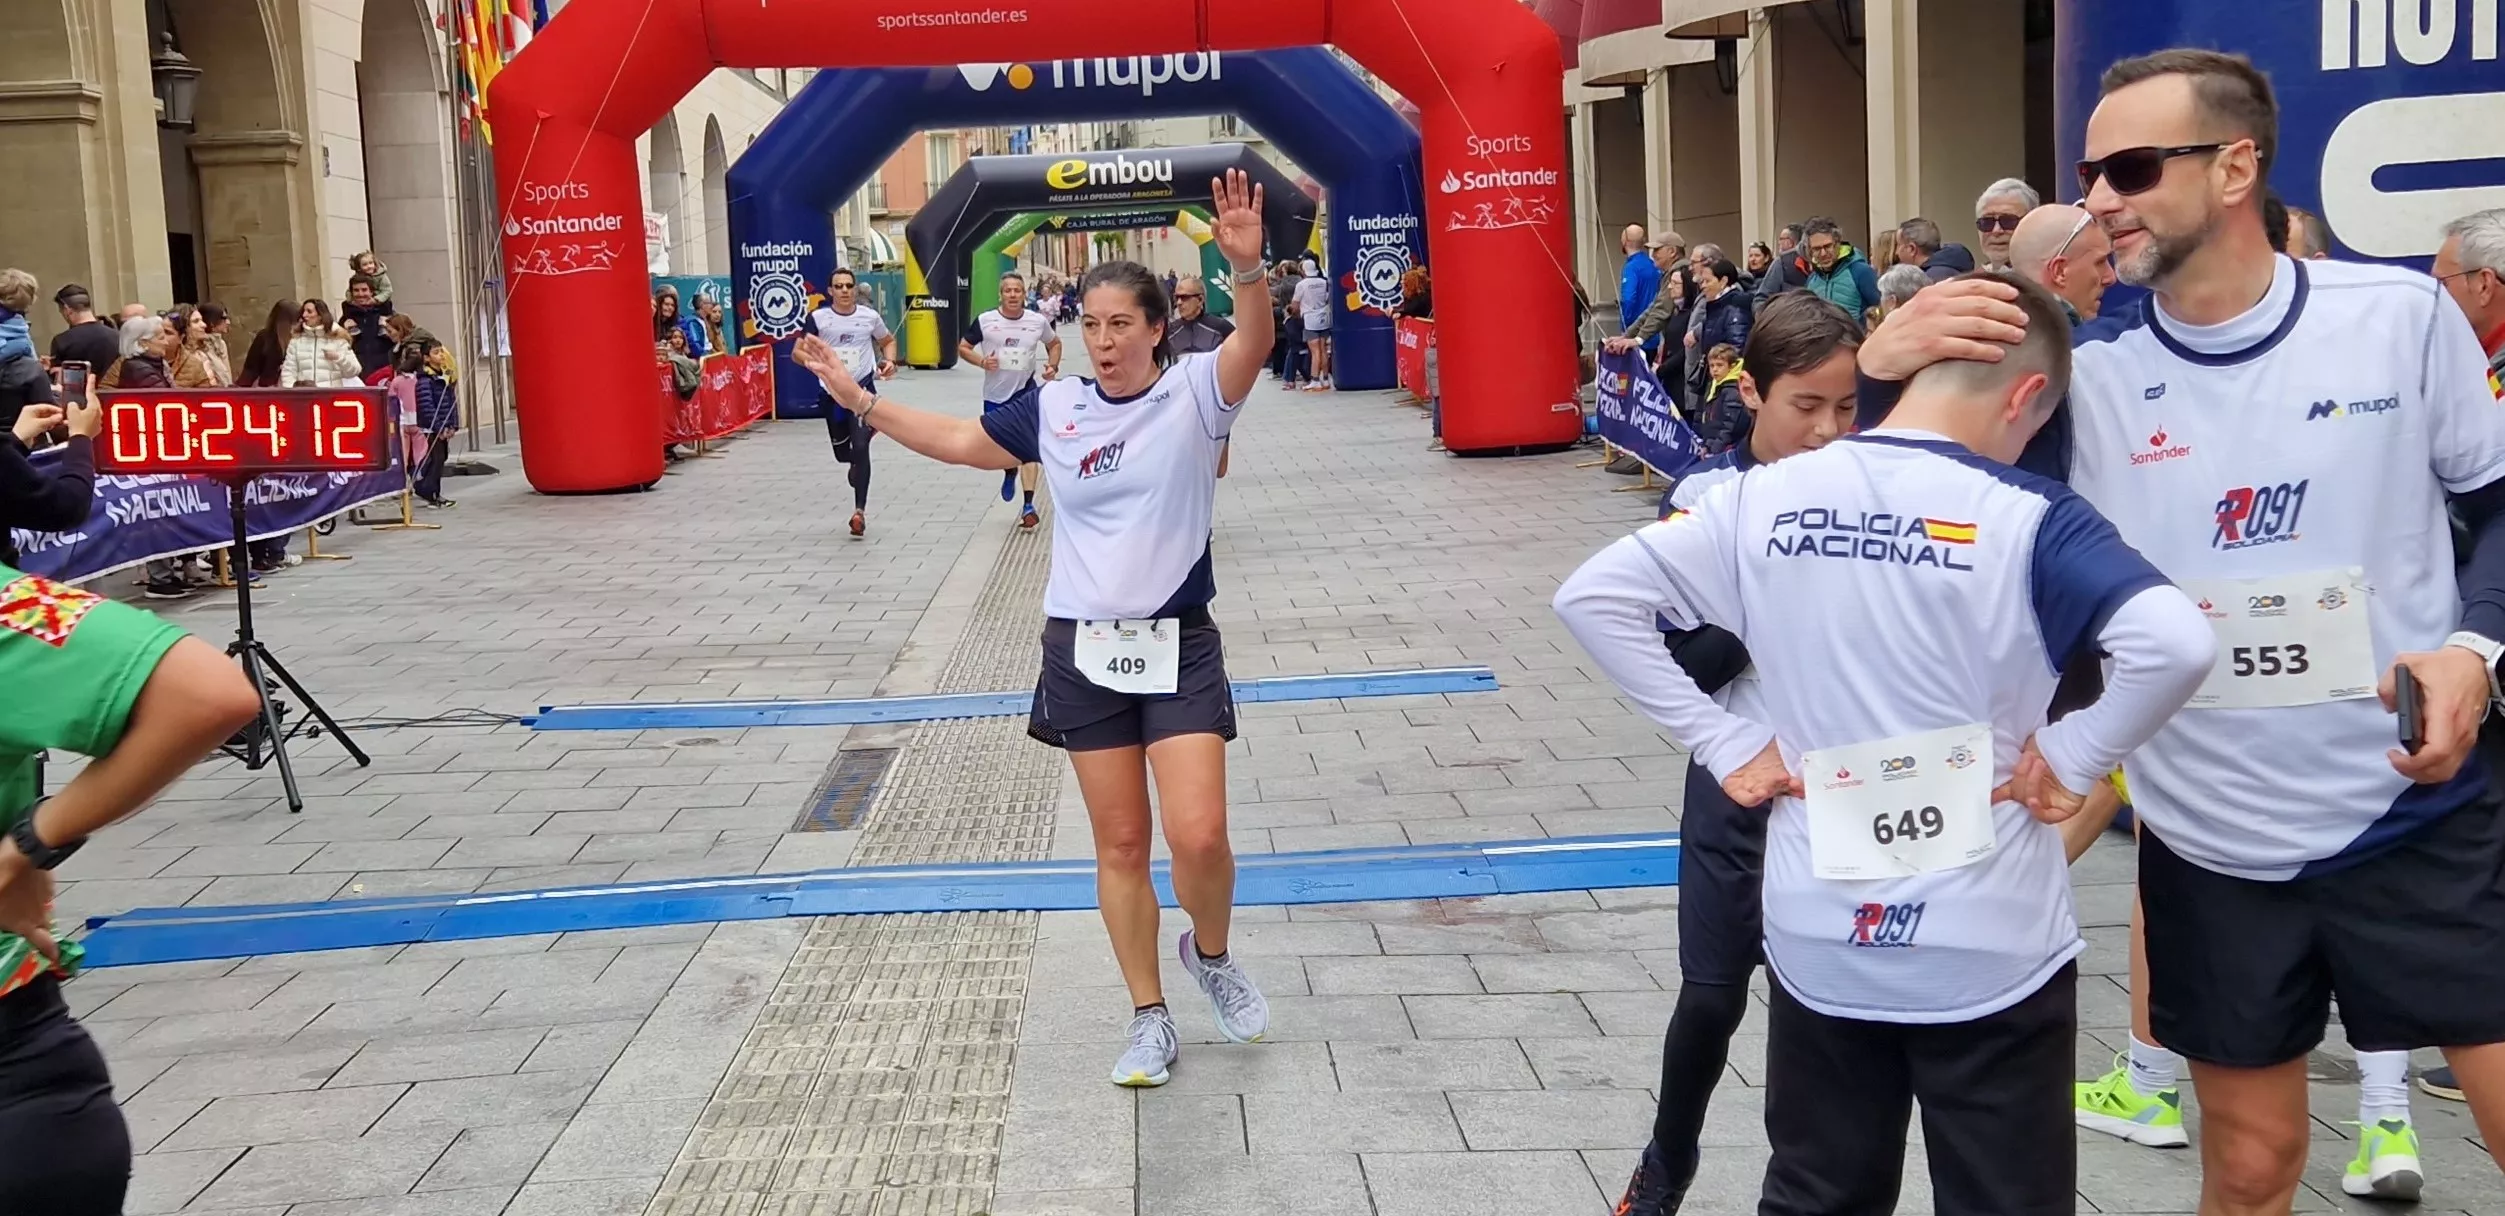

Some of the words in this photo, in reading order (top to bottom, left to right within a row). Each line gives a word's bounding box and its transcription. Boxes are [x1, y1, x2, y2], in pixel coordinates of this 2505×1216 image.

[877, 8, 1028, 31] sportssantander.es
[1467, 134, 1532, 159] Sports
[1046, 154, 1173, 190] embou
[1463, 166, 1558, 191] Santander
[523, 181, 589, 206] Sports
[522, 212, 623, 236] Santander
[1066, 221, 1088, 229] CAJA
[1089, 219, 1117, 227] RURAL
[1119, 217, 1129, 225] DE
[1132, 215, 1167, 224] ARAGÓN
[1348, 213, 1418, 231] fundación
[741, 240, 813, 258] fundación
[1360, 229, 1406, 247] mupol
[752, 257, 799, 273] mupol
[911, 296, 950, 309] embou
[2348, 392, 2401, 415] mupol
[2130, 445, 2192, 466] Santander
[226, 474, 318, 509] ACIONAL
[105, 484, 212, 528] NACIONAL
[1771, 507, 1932, 540] POLICIA
[1766, 534, 1974, 572] NACIONAL
[1106, 656, 1147, 675] 409
[2232, 643, 2310, 677] 553
[1872, 805, 1944, 846] 649
